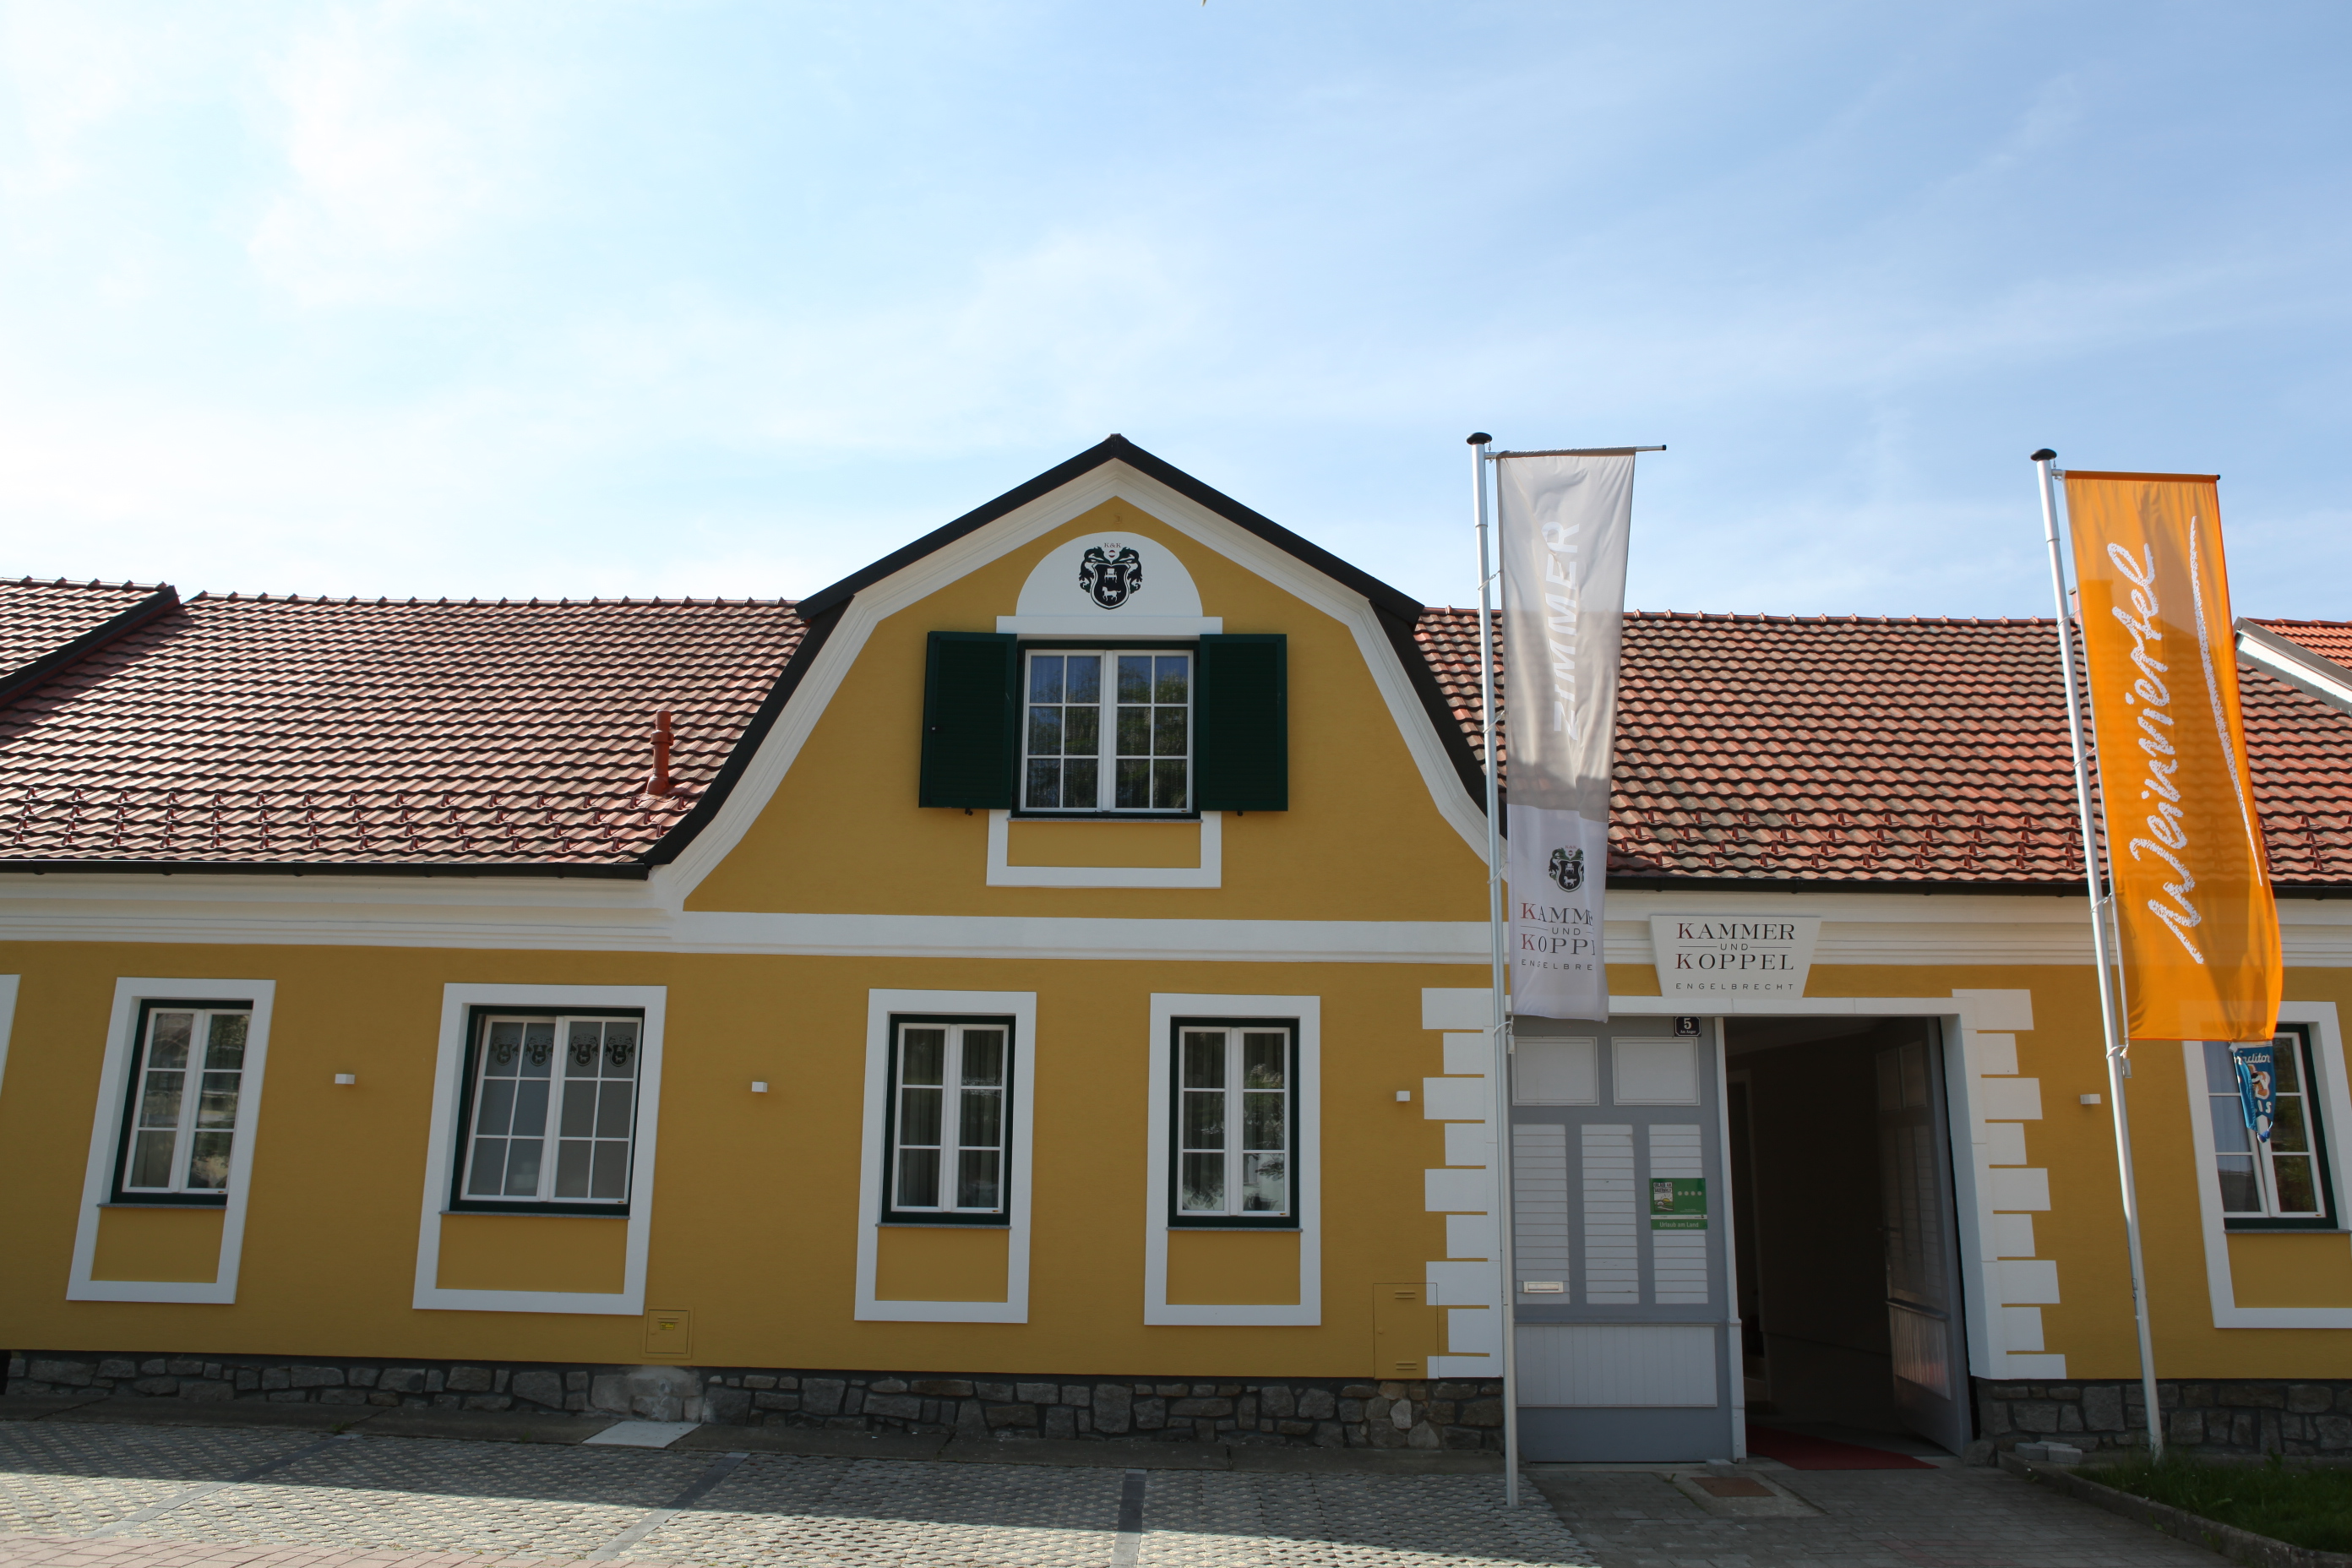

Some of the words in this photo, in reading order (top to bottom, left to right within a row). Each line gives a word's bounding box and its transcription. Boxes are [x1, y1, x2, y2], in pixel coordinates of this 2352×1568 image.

[1540, 520, 1580, 741] ZIMMER
[2107, 542, 2204, 965] Weinviertel
[1551, 927, 1582, 936] UND
[1675, 923, 1796, 940] KAMMER
[1719, 943, 1749, 951] UND
[1674, 953, 1794, 971] KOPPEL
[1684, 1017, 1692, 1030] 5
